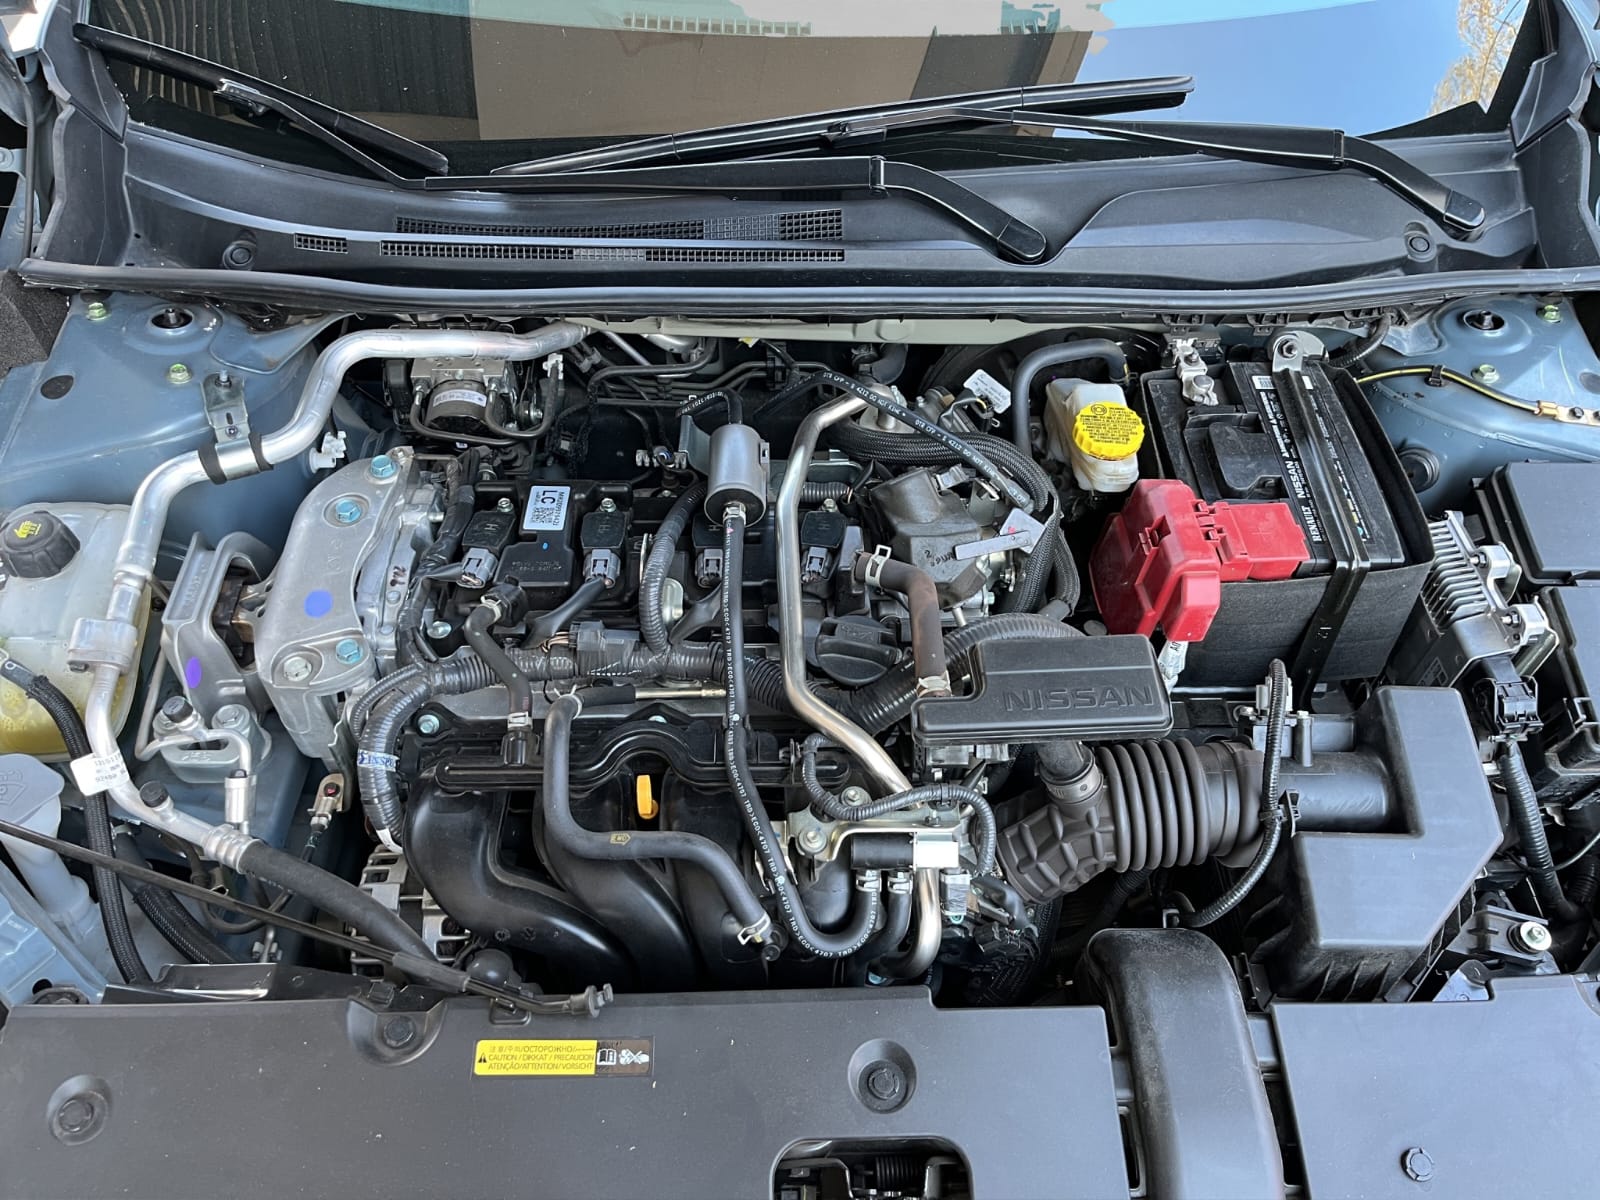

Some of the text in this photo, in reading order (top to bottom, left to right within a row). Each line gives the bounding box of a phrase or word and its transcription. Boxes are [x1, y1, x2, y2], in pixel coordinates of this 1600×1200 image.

[541, 490, 558, 504] LC
[1285, 461, 1322, 543] RENAULT NISSAN
[1002, 685, 1154, 712] NISSAN
[727, 748, 747, 798] TRD>ECO<4707
[743, 800, 770, 854] TRD>ECO<4707
[788, 917, 834, 958] TRD>ECO<4707
[837, 910, 877, 957] TRD>ECO<4707
